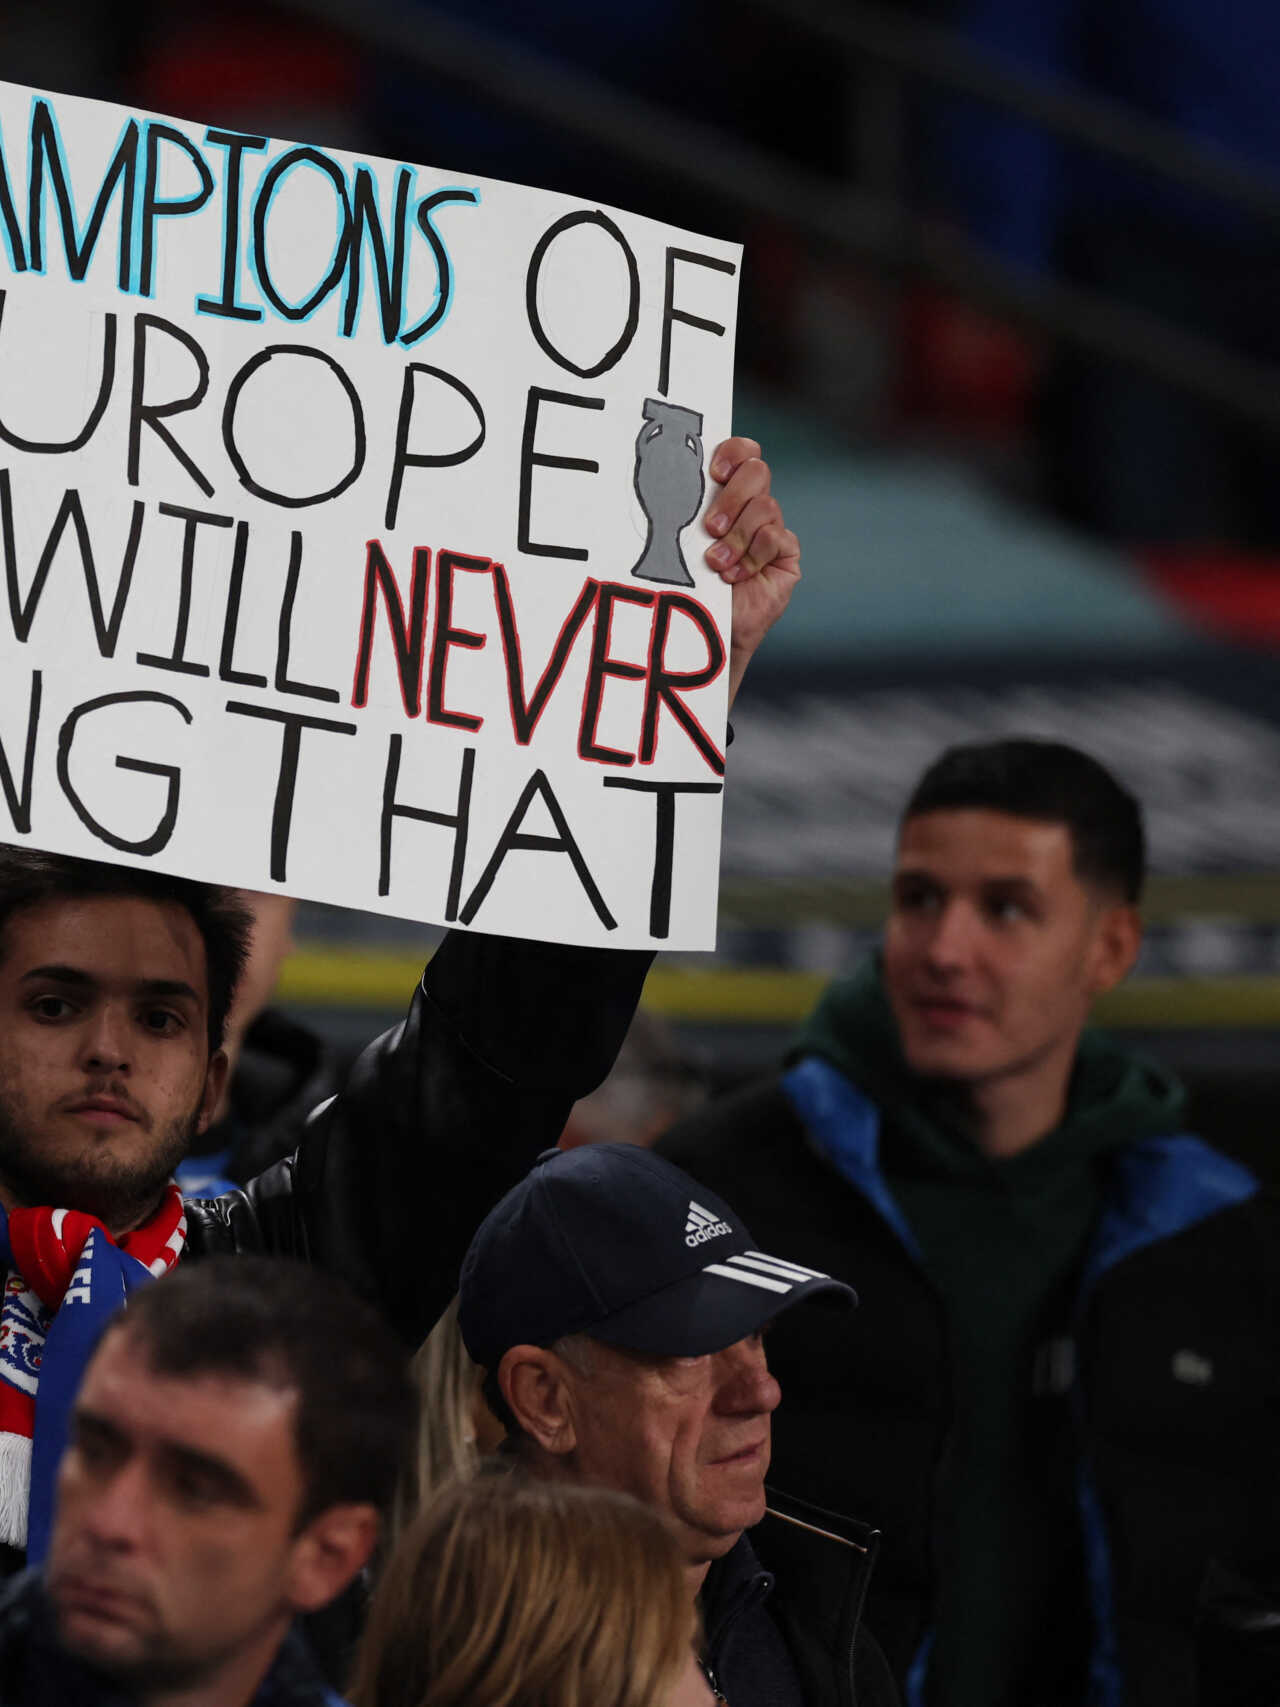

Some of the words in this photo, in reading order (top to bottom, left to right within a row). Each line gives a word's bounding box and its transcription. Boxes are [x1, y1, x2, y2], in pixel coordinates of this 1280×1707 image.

[526, 210, 736, 397] OF
[351, 539, 726, 776] NEVER
[225, 700, 723, 938] THAT
[685, 1221, 733, 1248] adidas
